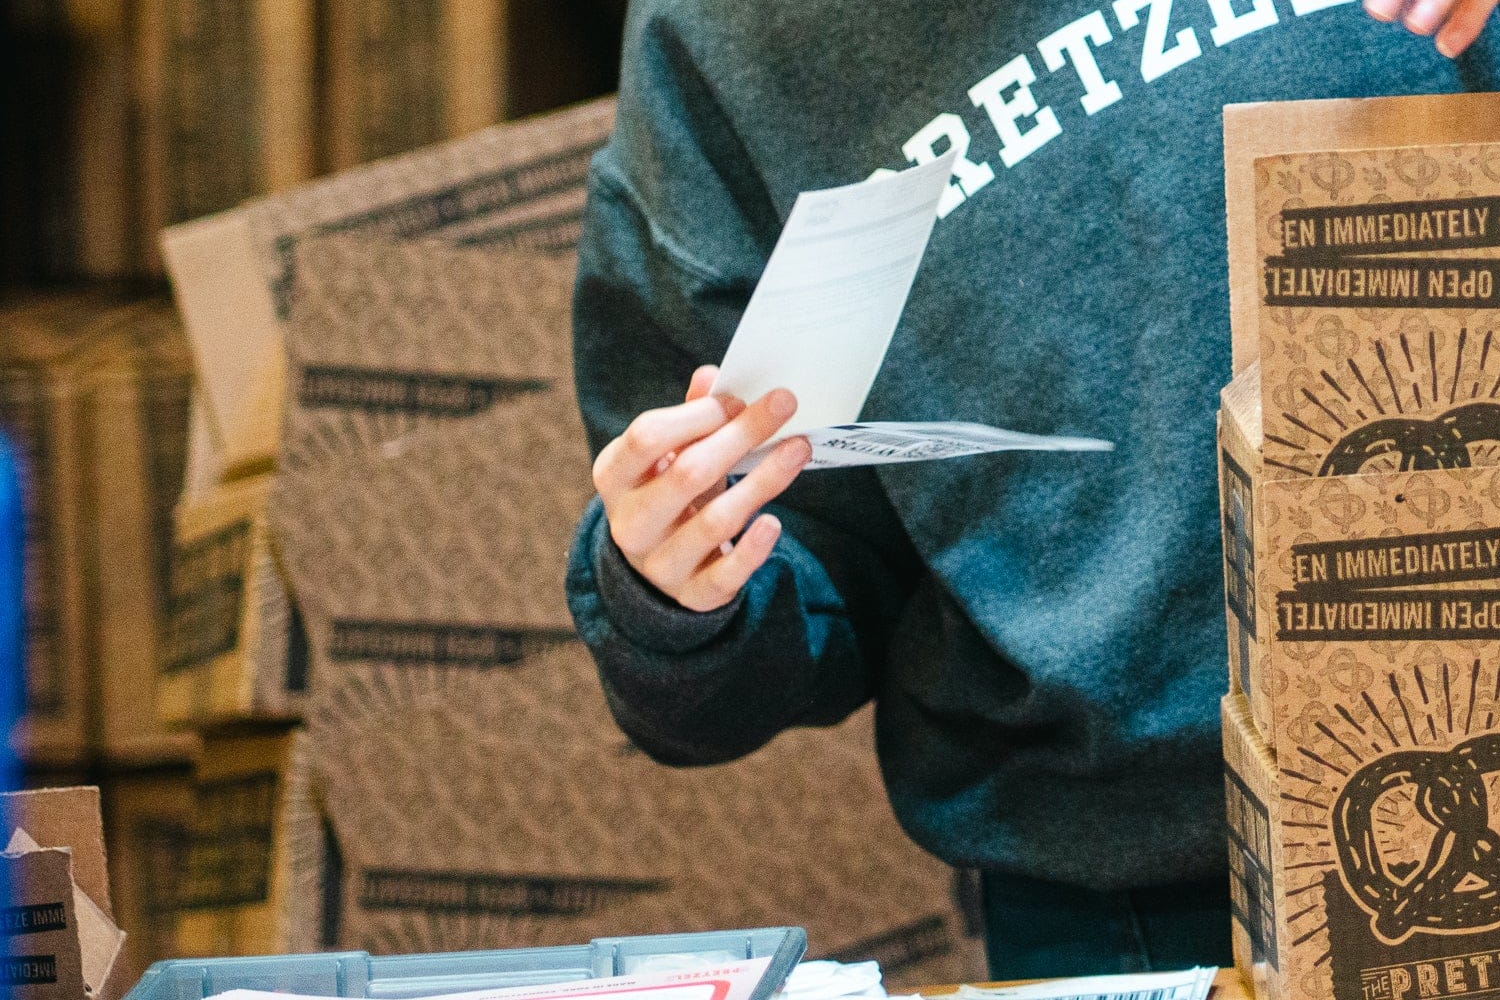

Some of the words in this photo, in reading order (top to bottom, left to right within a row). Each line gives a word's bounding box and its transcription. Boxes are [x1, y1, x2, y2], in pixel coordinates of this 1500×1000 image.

[1325, 207, 1488, 246] IMMEDIATELY
[1427, 268, 1492, 298] OPEN
[1336, 539, 1500, 580] IMMEDIATELY
[1362, 976, 1389, 1000] THE
